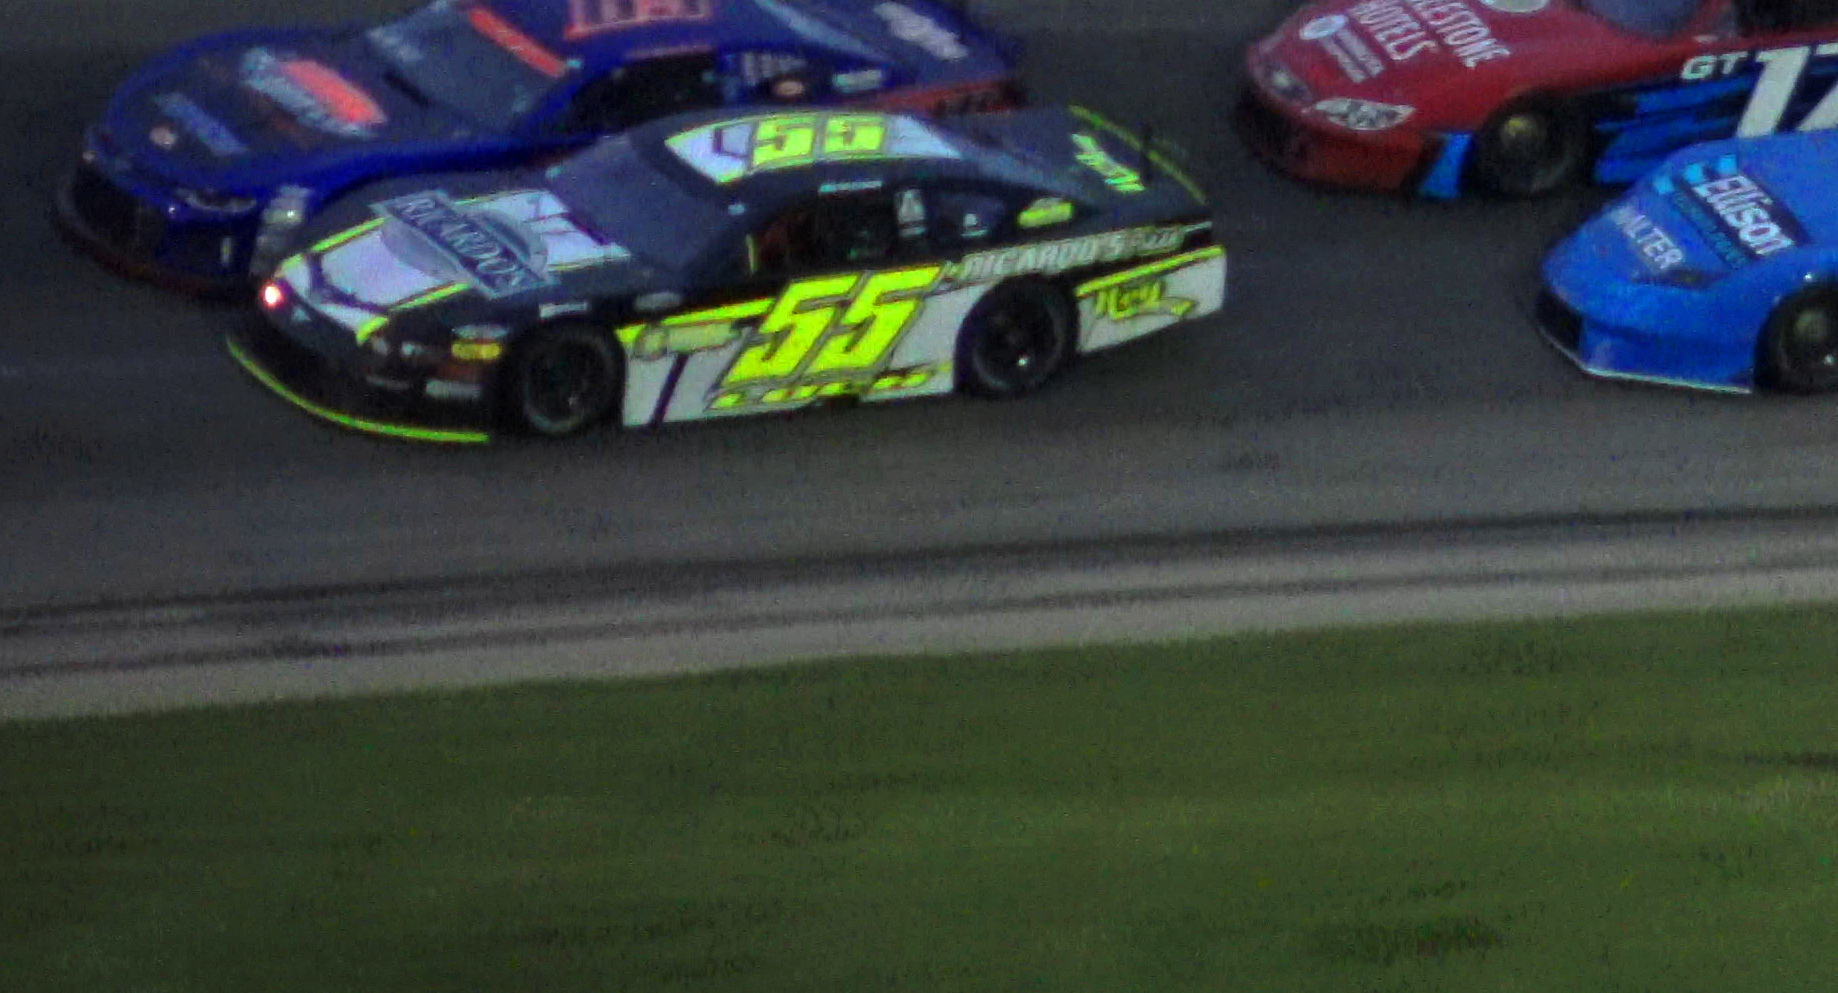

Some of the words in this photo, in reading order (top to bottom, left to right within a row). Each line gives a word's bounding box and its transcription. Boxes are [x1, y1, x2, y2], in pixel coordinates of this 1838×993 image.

[1680, 52, 1746, 80] GT
[752, 116, 885, 166] 55
[722, 266, 942, 384] 55
